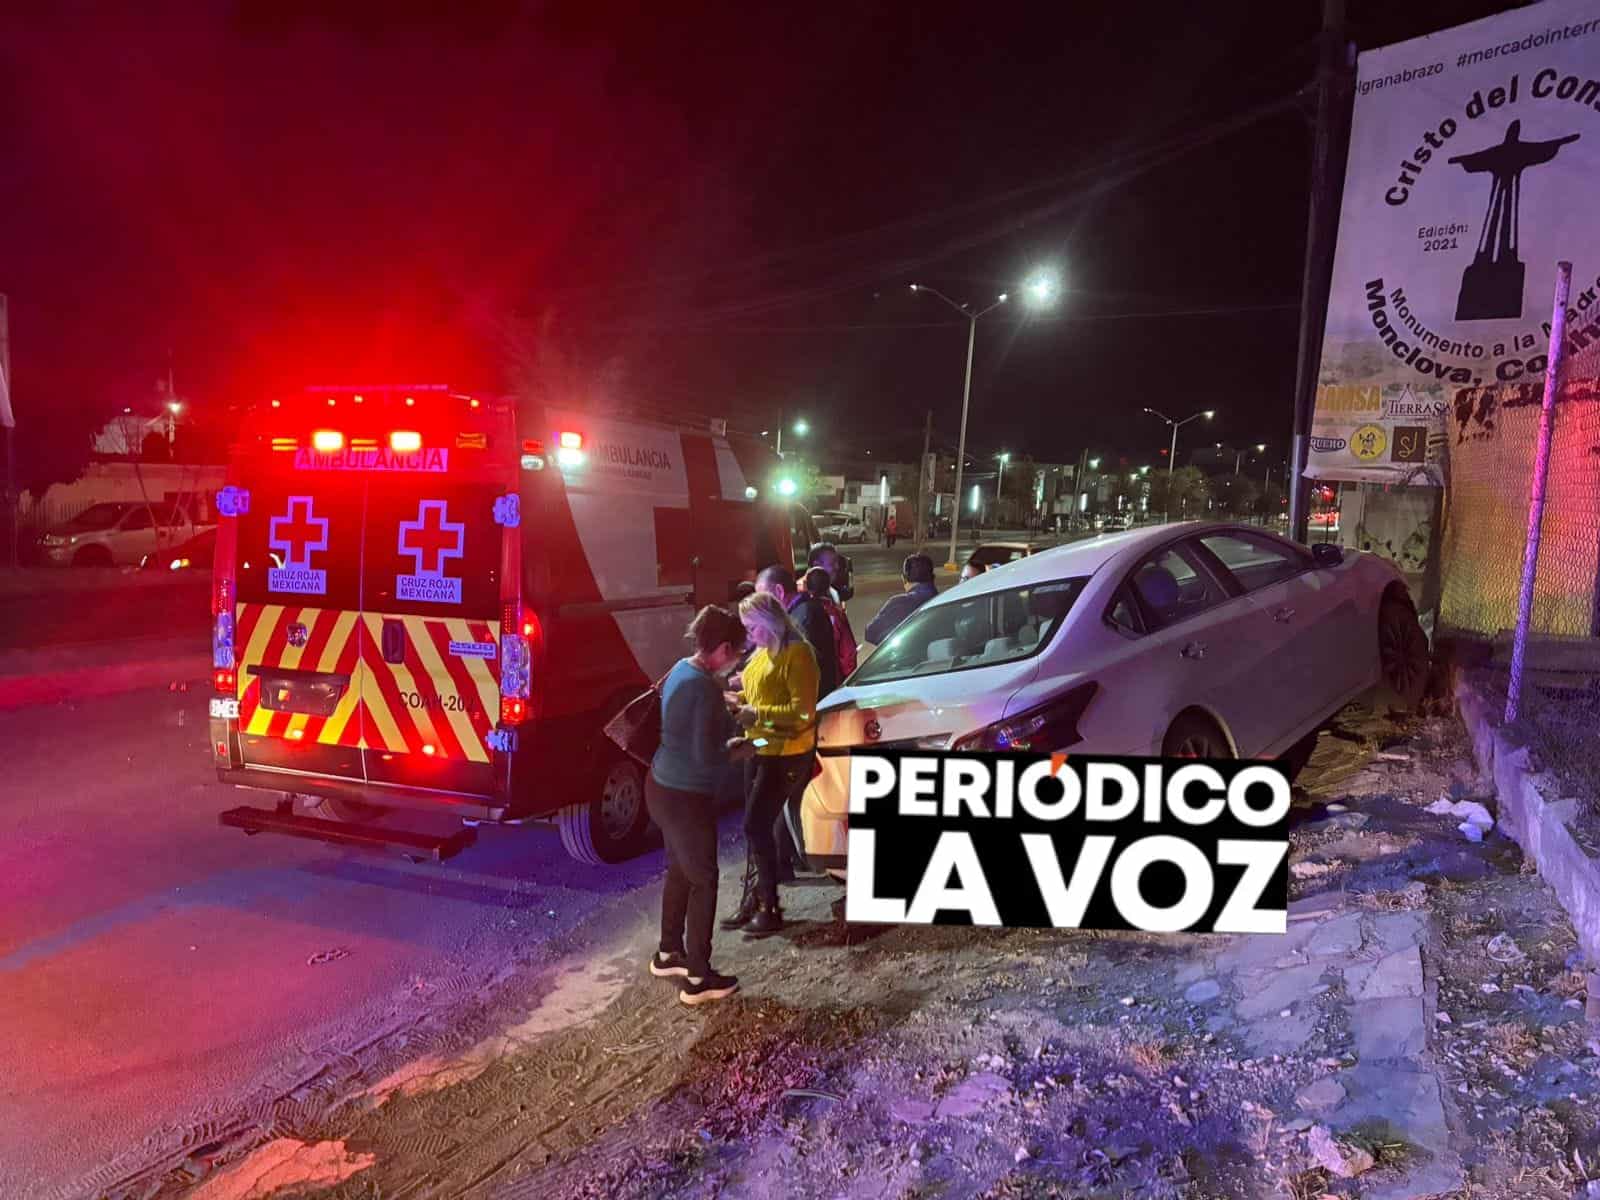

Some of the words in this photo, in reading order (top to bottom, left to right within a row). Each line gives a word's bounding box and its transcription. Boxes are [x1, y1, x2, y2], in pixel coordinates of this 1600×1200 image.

[1354, 61, 1444, 96] lgranabrazo
[1385, 118, 1457, 206] Cristo
[1465, 74, 1519, 119] del
[1423, 237, 1458, 251] 2021
[1365, 278, 1482, 386] Monclova,
[1390, 287, 1483, 358] Monumento
[1493, 343, 1505, 356] a
[1513, 334, 1535, 352] la
[297, 448, 443, 470] AMBULANCIA
[591, 445, 672, 470] MBULANCIA
[272, 570, 295, 580] CRUZ
[297, 571, 320, 581] ROJA
[272, 580, 320, 591] MEXICANA
[401, 577, 426, 588] CRUZ
[429, 579, 455, 590] ROJA
[401, 588, 455, 600] MEXICANA
